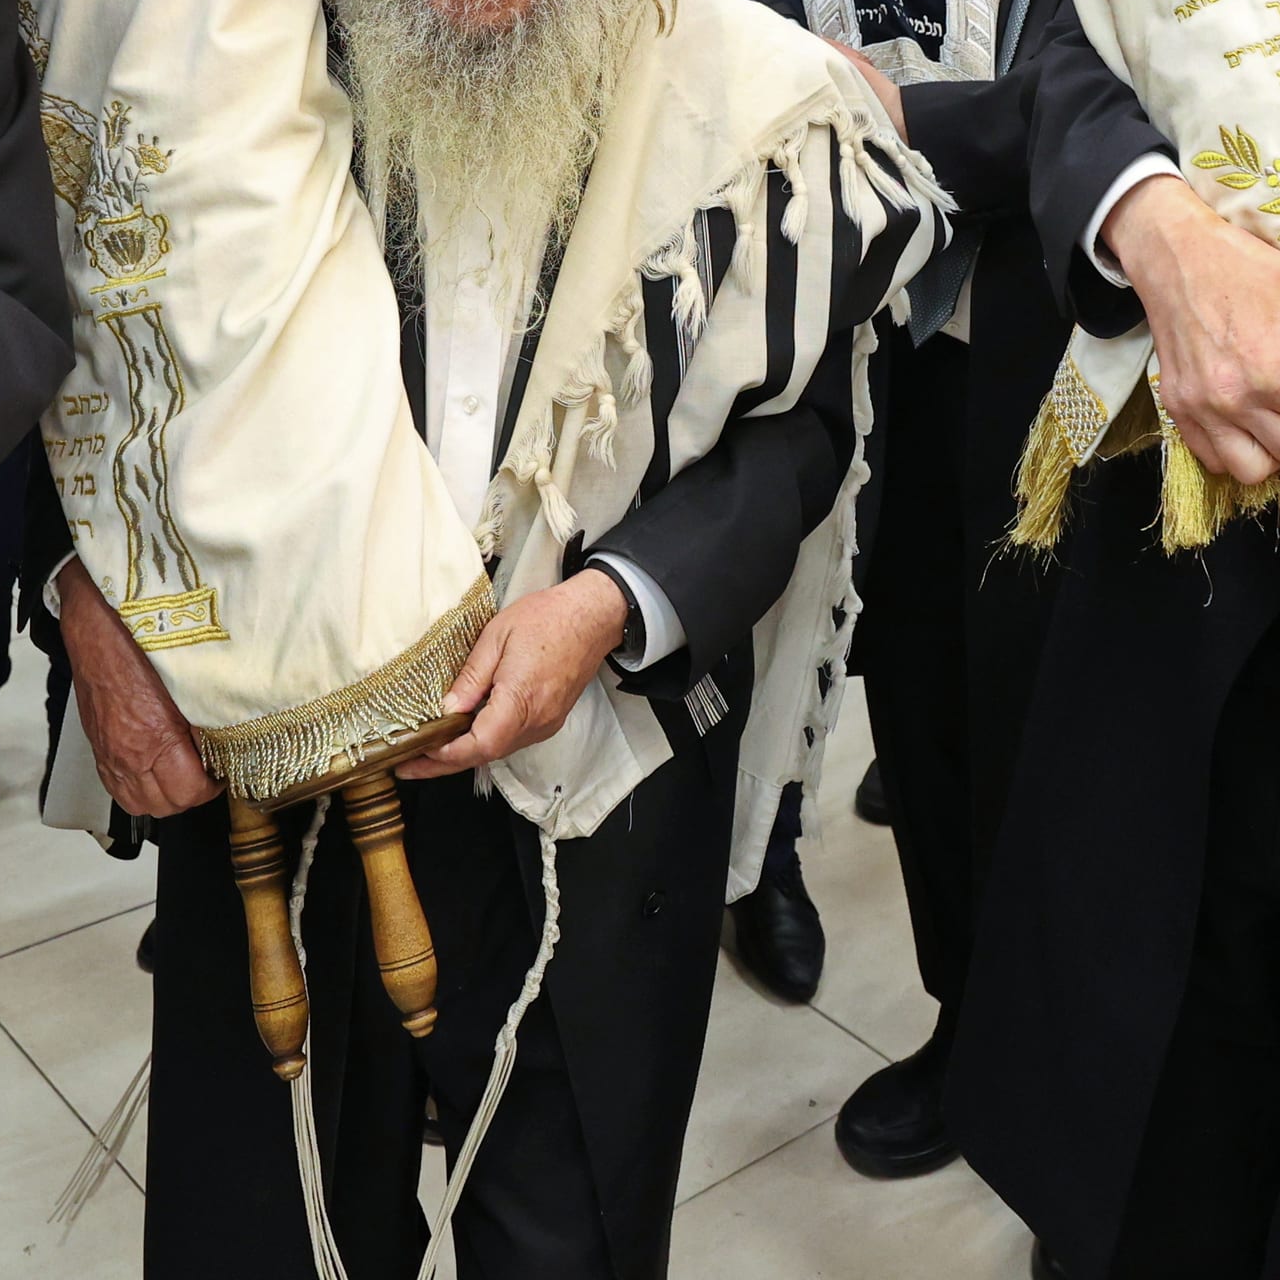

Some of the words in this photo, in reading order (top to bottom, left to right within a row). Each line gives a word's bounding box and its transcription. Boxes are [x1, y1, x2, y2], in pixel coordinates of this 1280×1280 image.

[62, 391, 110, 417] נכתב
[69, 432, 106, 457] מרת
[71, 471, 97, 497] בת
